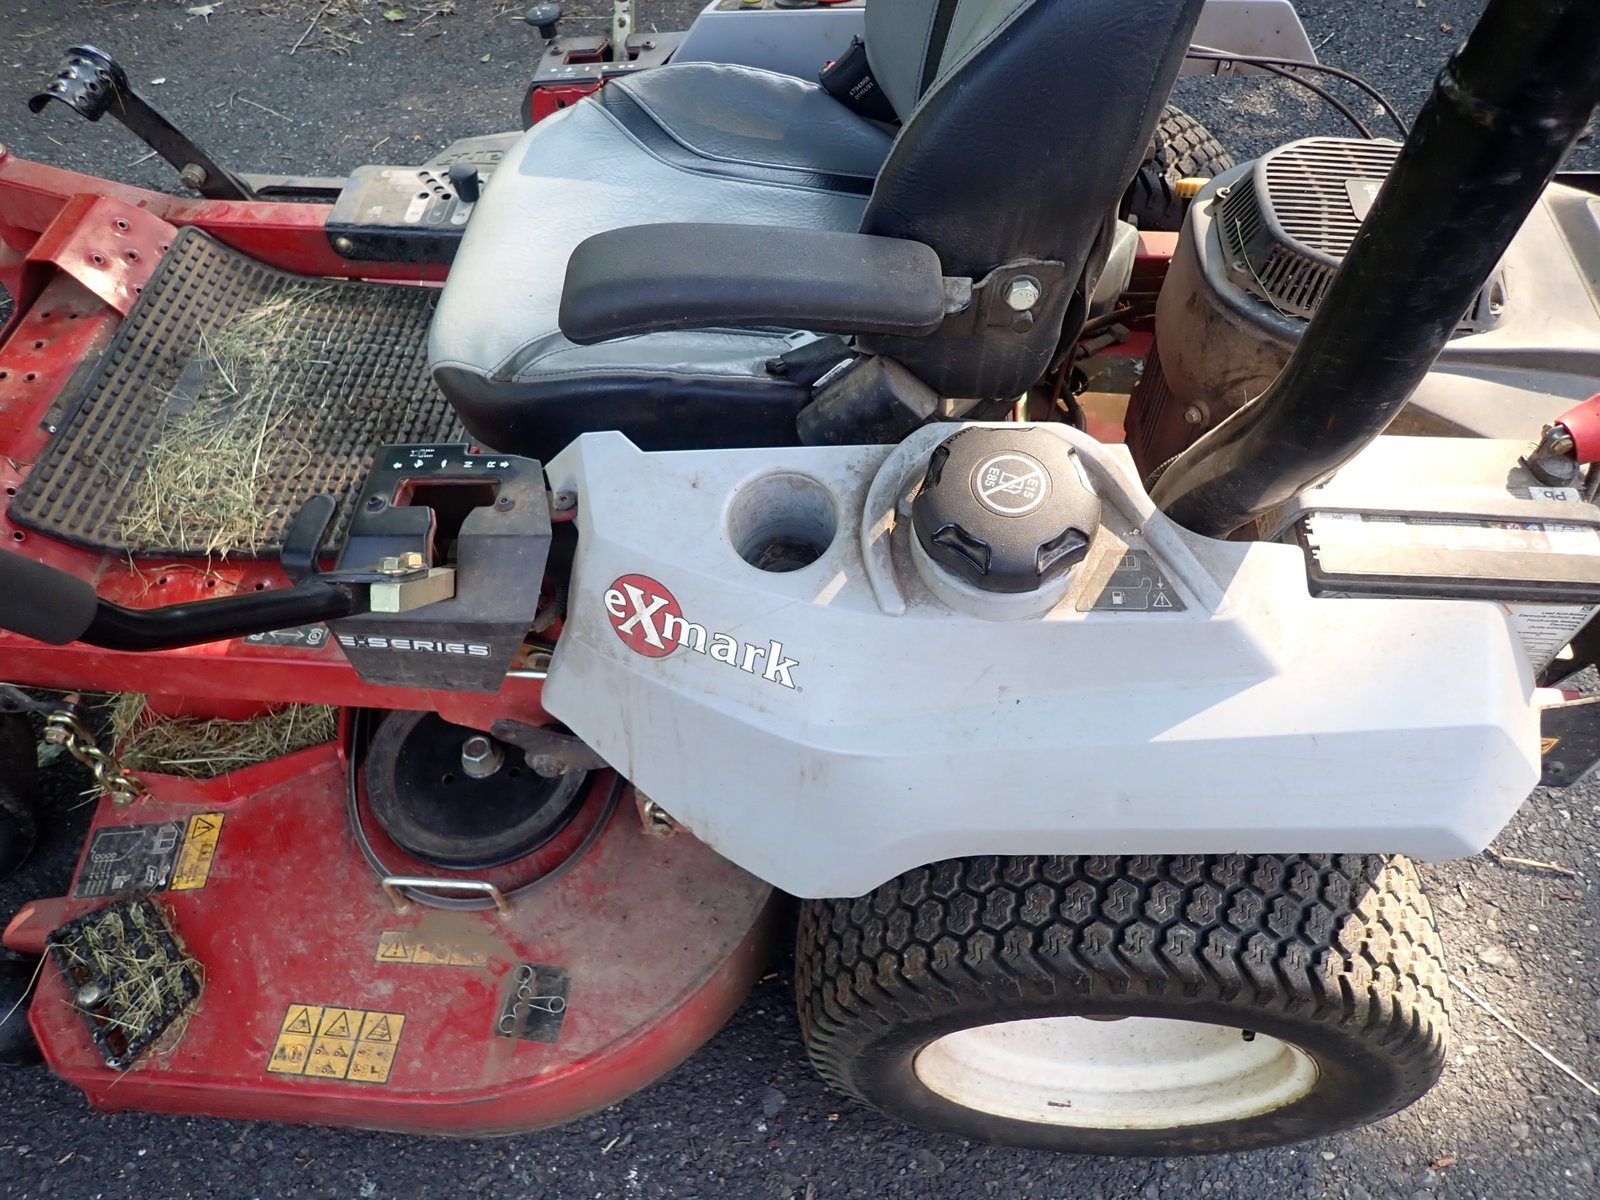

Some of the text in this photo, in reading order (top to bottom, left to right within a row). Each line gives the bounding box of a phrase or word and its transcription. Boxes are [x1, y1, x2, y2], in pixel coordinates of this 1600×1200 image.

[984, 467, 1000, 487] E85
[1023, 478, 1039, 499] E15
[1543, 490, 1567, 501] Pb
[338, 635, 490, 657] E-SERIES
[603, 582, 800, 690] eXmark
